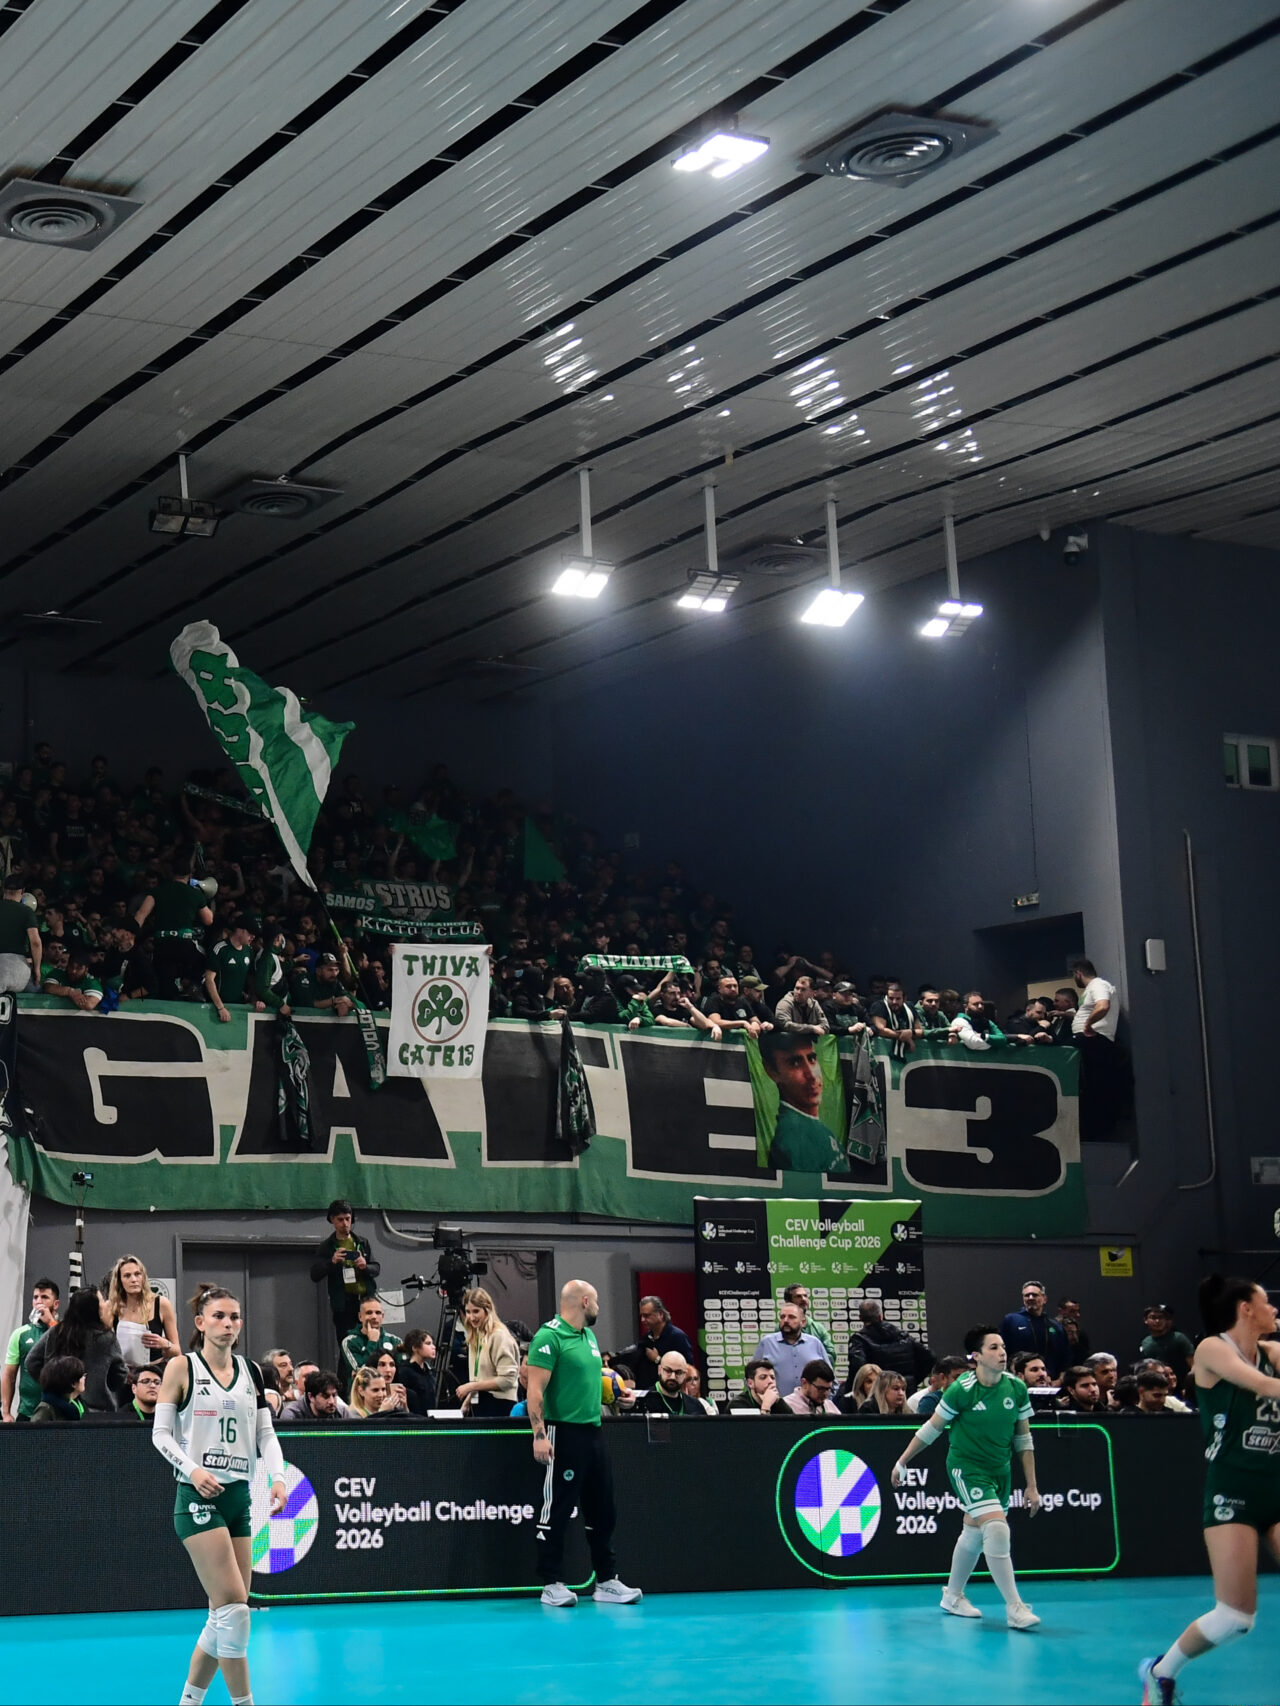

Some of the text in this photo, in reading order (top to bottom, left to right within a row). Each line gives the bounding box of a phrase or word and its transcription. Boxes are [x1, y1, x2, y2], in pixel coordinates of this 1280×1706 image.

[325, 892, 376, 912] SAMOS
[361, 915, 418, 936] KIATO
[402, 954, 480, 977] THIVA
[14, 1013, 779, 1180] GATE
[785, 1218, 865, 1233] CEV Volleyball
[770, 1234, 881, 1251] Challenge Cup 2026
[218, 1416, 238, 1444] 16
[335, 1477, 376, 1498] CEV
[900, 1467, 929, 1487] EV
[894, 1490, 965, 1514] Volleyb
[1067, 1488, 1102, 1511] Cup
[335, 1499, 535, 1528] Volleyball Challenge
[895, 1515, 937, 1535] 2026
[335, 1526, 384, 1550] 2026
